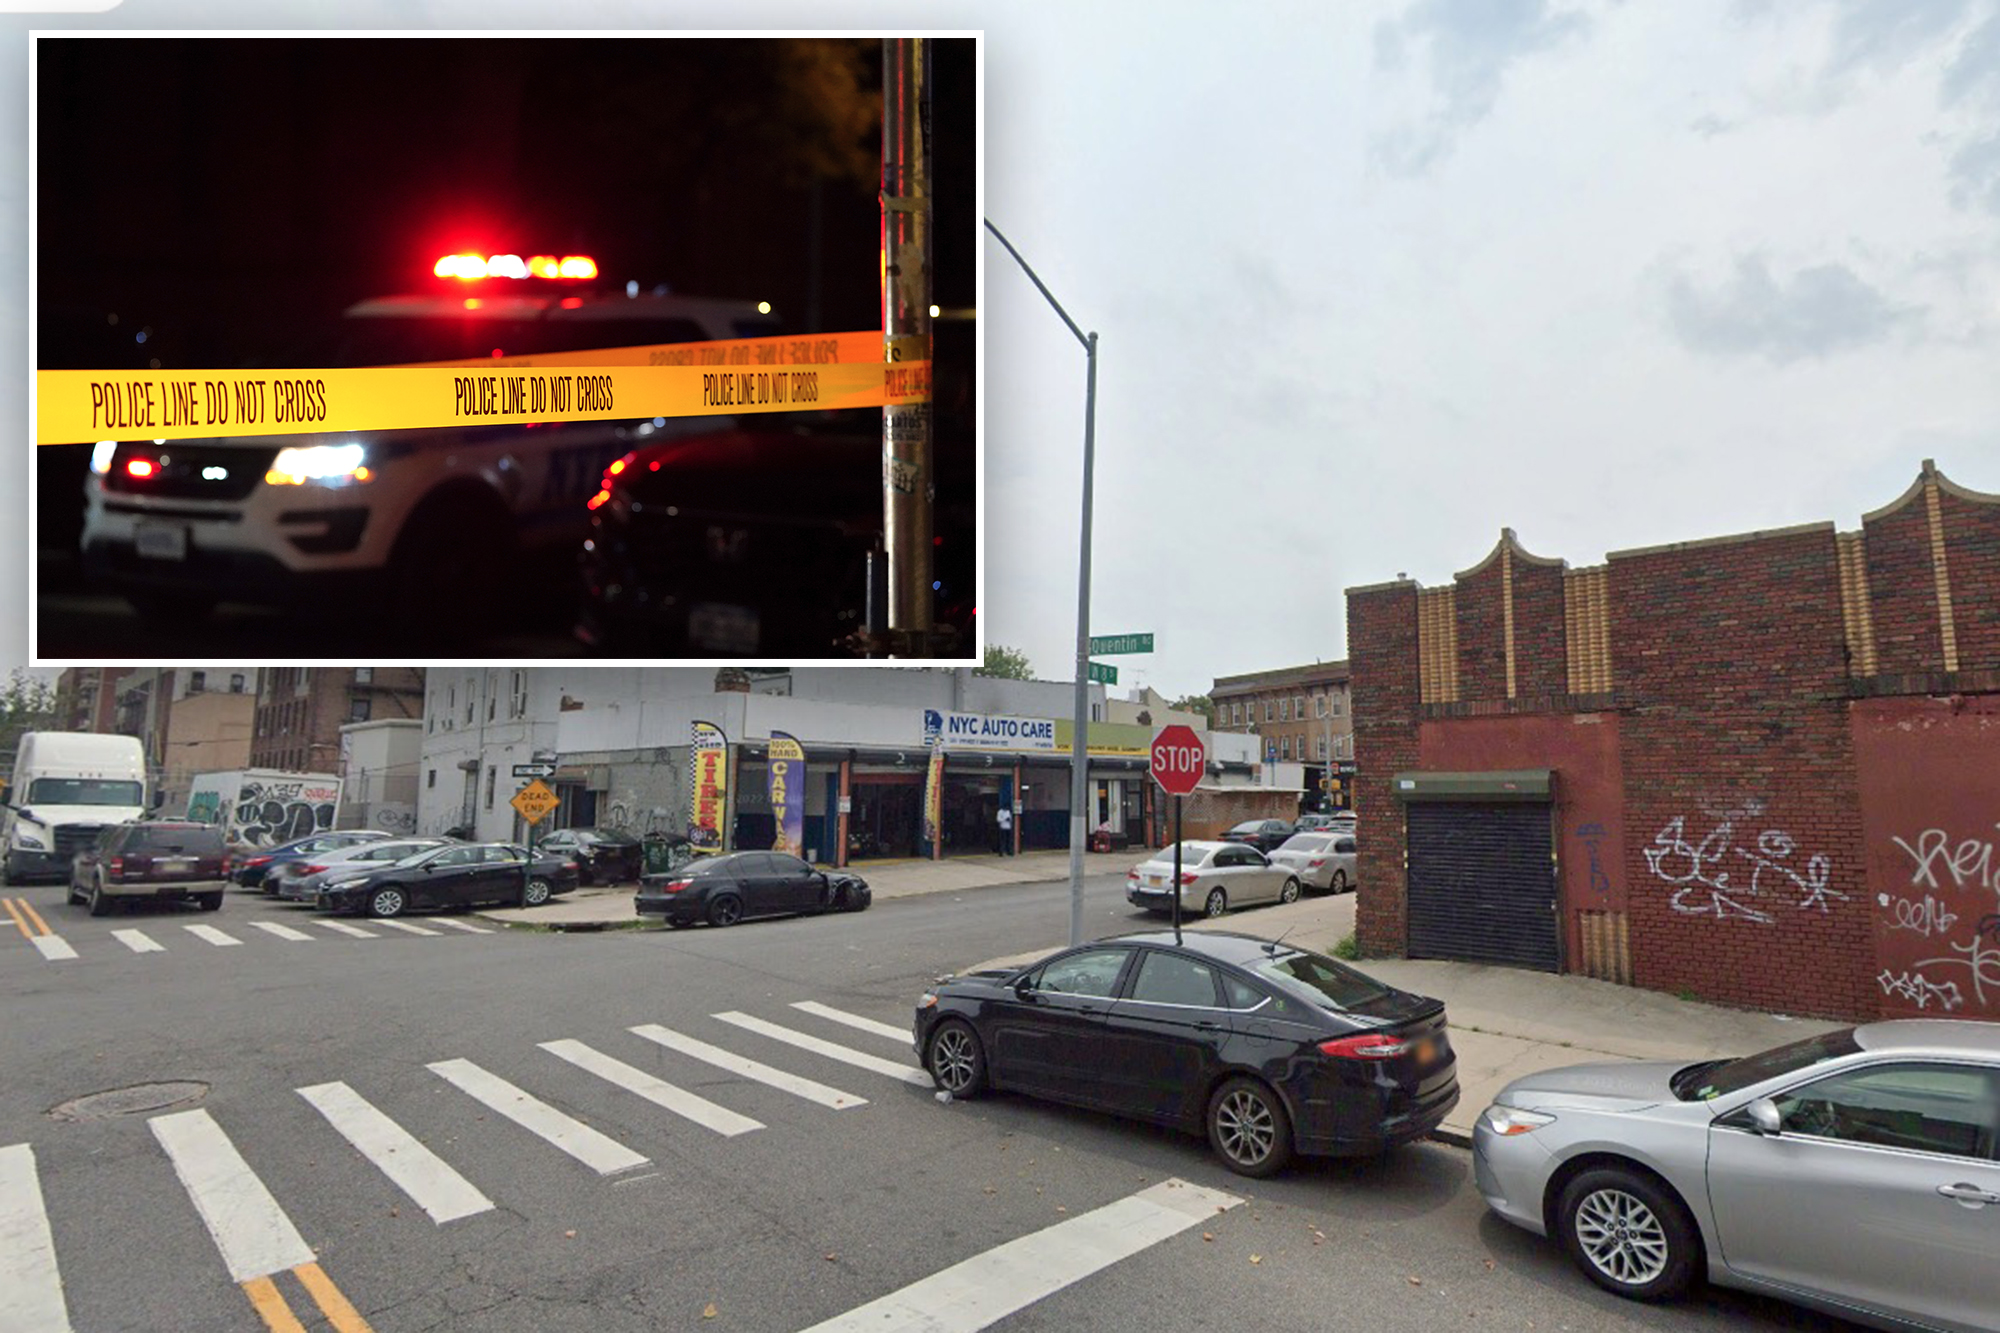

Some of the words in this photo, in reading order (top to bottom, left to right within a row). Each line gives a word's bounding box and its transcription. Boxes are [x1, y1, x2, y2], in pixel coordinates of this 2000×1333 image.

[454, 377, 498, 416] POLICE
[500, 377, 527, 414] LINE
[530, 376, 546, 413] DO
[550, 376, 572, 413] NOT
[576, 375, 614, 411] CROSS
[703, 373, 734, 406] POLICE
[736, 373, 755, 405] LINE
[758, 372, 770, 404] DO
[771, 372, 788, 404] NOT
[791, 371, 818, 403] CROSS
[90, 382, 156, 429] POLICE
[161, 381, 199, 427] LINE
[204, 380, 229, 425] DO
[234, 380, 266, 425] NOT
[273, 379, 327, 423] CROSS
[1092, 635, 1137, 654] Quentin
[949, 716, 978, 735] NYC
[981, 718, 1018, 737] AUTO
[1021, 721, 1053, 739] CARE
[770, 749, 799, 758] HAND
[771, 741, 796, 749] 100%
[1154, 745, 1203, 773] STOP
[699, 751, 721, 831] TIRES
[771, 761, 788, 804] CAR
[520, 792, 550, 801] DEAD
[524, 803, 545, 813] END
